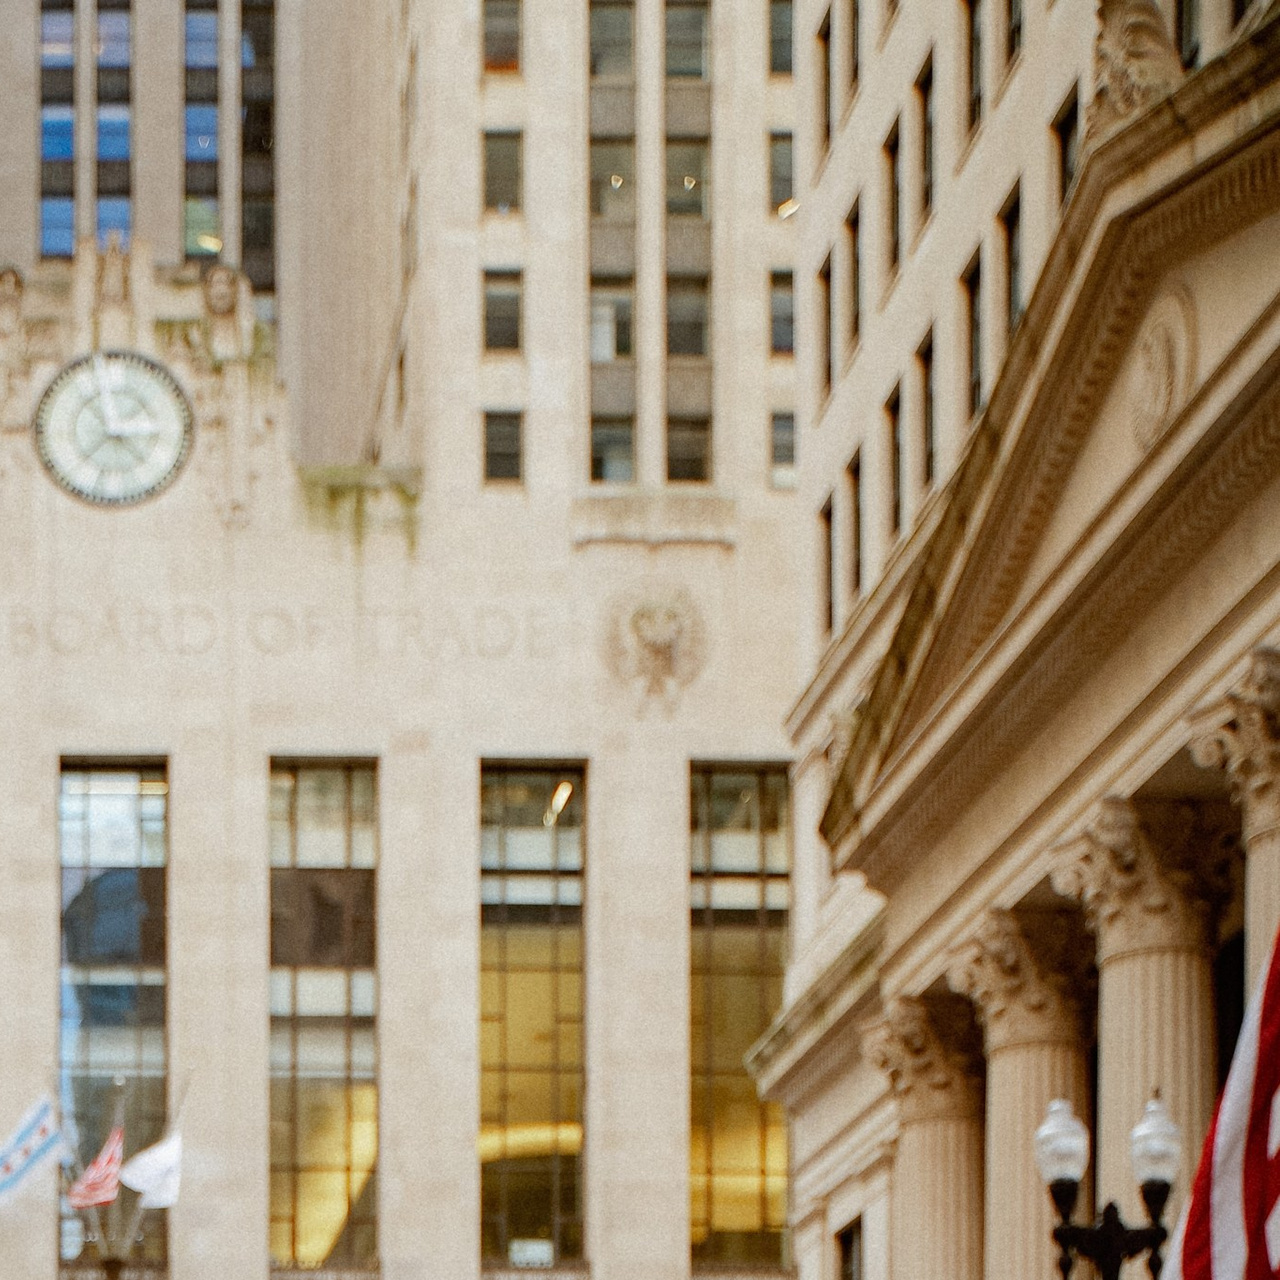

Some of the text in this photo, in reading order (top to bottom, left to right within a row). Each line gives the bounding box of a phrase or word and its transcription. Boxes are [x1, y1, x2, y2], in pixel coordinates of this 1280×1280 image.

[7, 604, 217, 658] BOARD
[249, 604, 329, 658] OF
[363, 604, 558, 660] TRADE
